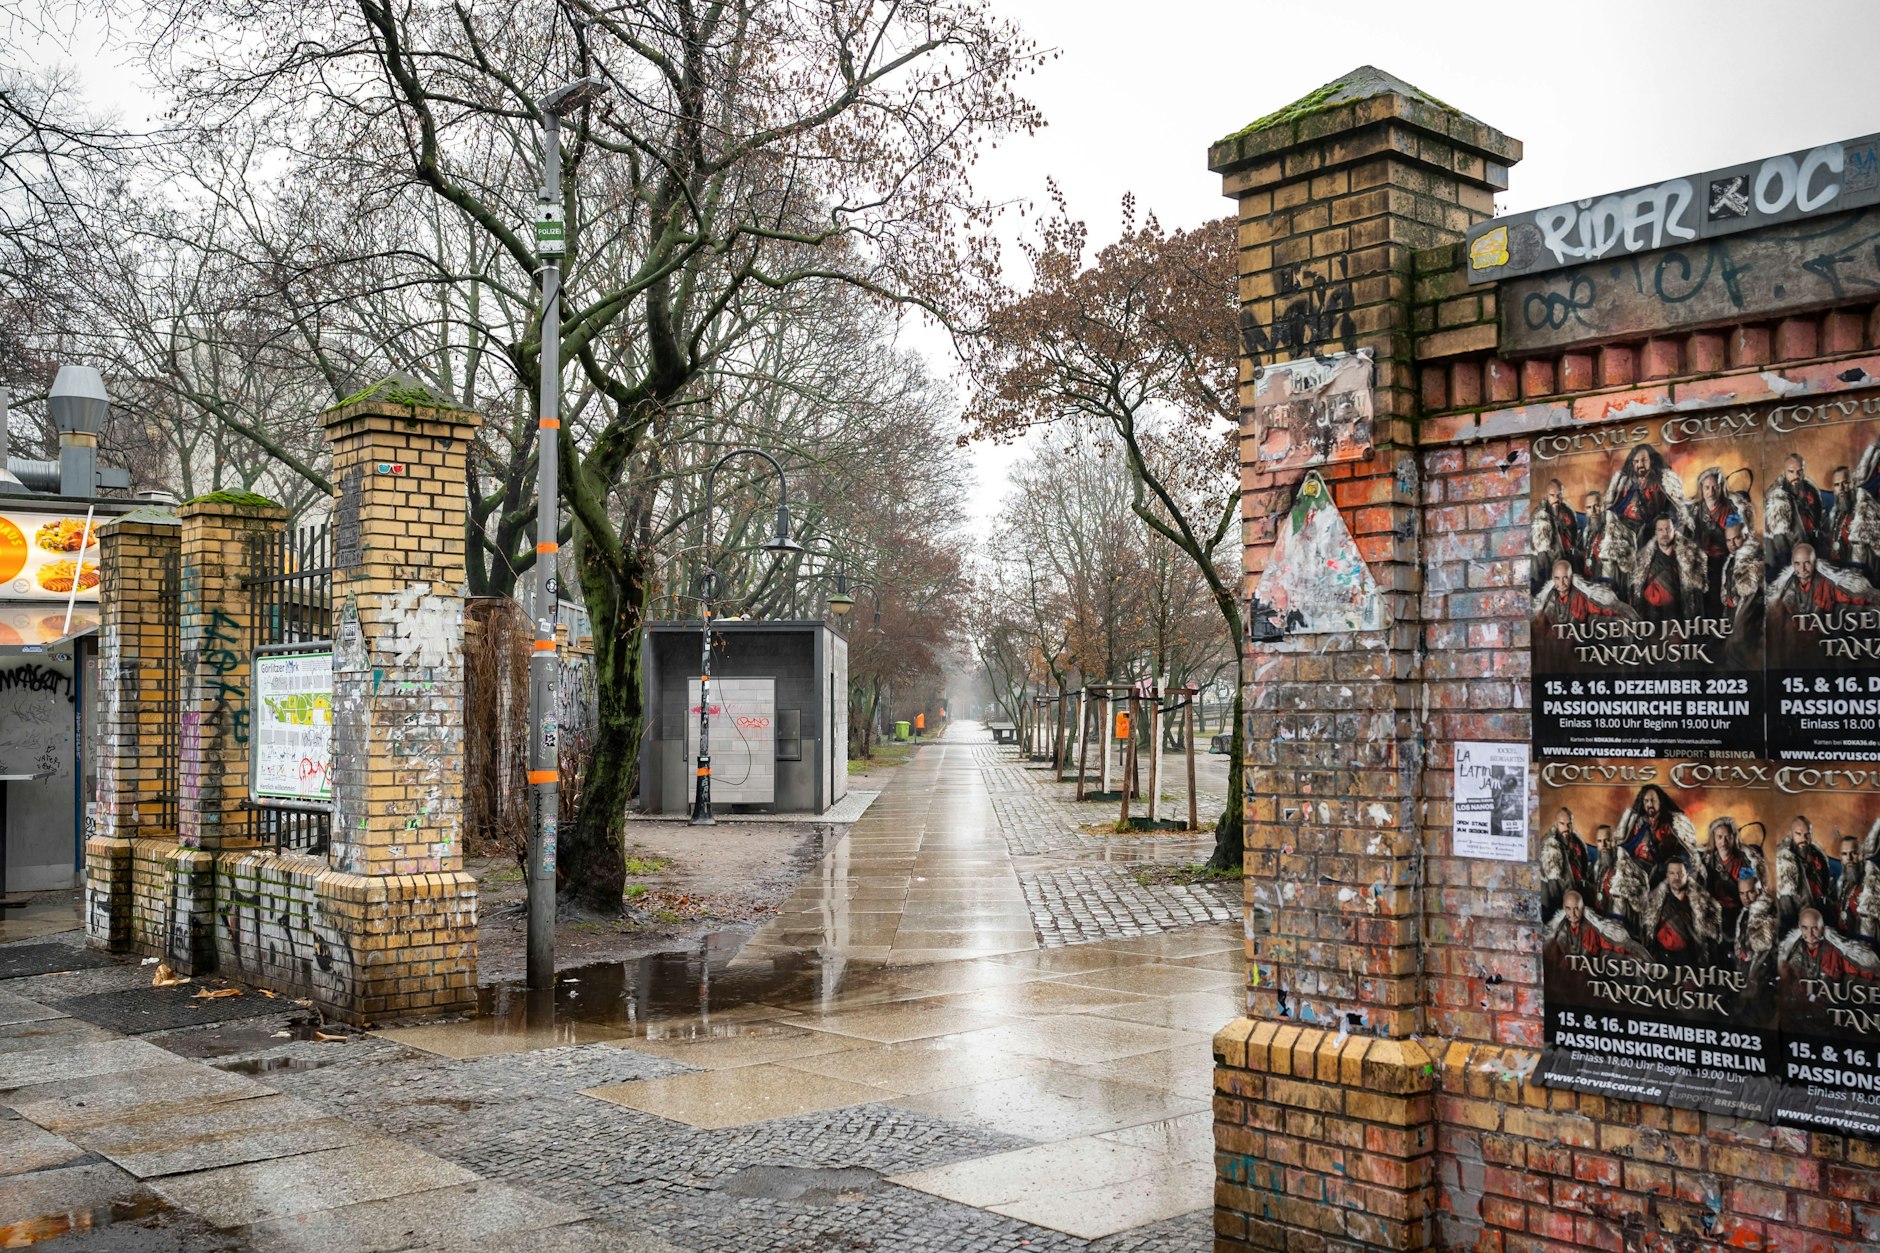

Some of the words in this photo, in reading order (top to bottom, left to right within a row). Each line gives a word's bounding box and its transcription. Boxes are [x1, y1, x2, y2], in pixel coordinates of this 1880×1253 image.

[1533, 422, 1650, 461] Corvus
[1660, 409, 1760, 445] Corax
[1552, 618, 1655, 642] TAUSEND
[1660, 615, 1734, 639] JAHRE
[1575, 640, 1714, 666] TANZMUSIK
[261, 663, 285, 673] Görlitzer
[1544, 681, 1568, 695] 15.
[1570, 681, 1584, 695] &
[1587, 681, 1610, 695] 16.
[1614, 680, 1702, 695] DEZEMBER
[1706, 679, 1748, 694] 2023
[1782, 677, 1810, 693] 15.
[1814, 677, 1830, 693] &
[1834, 677, 1862, 693] 16.
[1543, 700, 1682, 716] PASSIONSKIRCHE
[1686, 701, 1750, 716] BERLIN
[1559, 718, 1592, 728] Einlass
[1594, 718, 1620, 728] 18.00
[1622, 718, 1642, 728] Uhr
[1644, 719, 1678, 732] Beginn
[1681, 719, 1708, 730] 19.00
[1711, 719, 1731, 730] Uhr
[1800, 718, 1840, 729] Einlass
[1843, 719, 1875, 730] 18.00
[1456, 749, 1470, 762] LA
[1543, 747, 1656, 758] www.corvuscorax.de
[1664, 749, 1707, 758] SUPPORT:
[1709, 750, 1756, 759] BRISINGA
[1542, 762, 1657, 788] Corvus
[1670, 763, 1771, 790] Corax
[1564, 954, 1668, 982] TAUSEND
[1673, 964, 1748, 992] JAHRE
[1587, 980, 1730, 1016] TANZMUSIK
[1558, 1012, 1580, 1028] 15.
[1584, 1015, 1597, 1029] &
[1600, 1017, 1624, 1033] 16.
[1628, 1020, 1717, 1045] DEZEMBER
[1720, 1031, 1762, 1051] 2023
[1556, 1032, 1696, 1064] PASSIONSKIRCHE
[1701, 1052, 1766, 1072] BERLIN
[1788, 1042, 1817, 1059] 15.
[1822, 1046, 1838, 1062] &
[1844, 1049, 1872, 1067] 16.
[1571, 1051, 1604, 1064] Einlass
[1606, 1056, 1634, 1068] 18.00
[1636, 1060, 1655, 1071] Uhr
[1656, 1064, 1692, 1077] Beginn
[1696, 1068, 1724, 1081] 19.00
[1726, 1072, 1747, 1084] Uhr
[1544, 1071, 1662, 1097] www.corvuscorax.de
[1714, 1098, 1762, 1112] BRISINGA
[1808, 1085, 1847, 1101] Einlass
